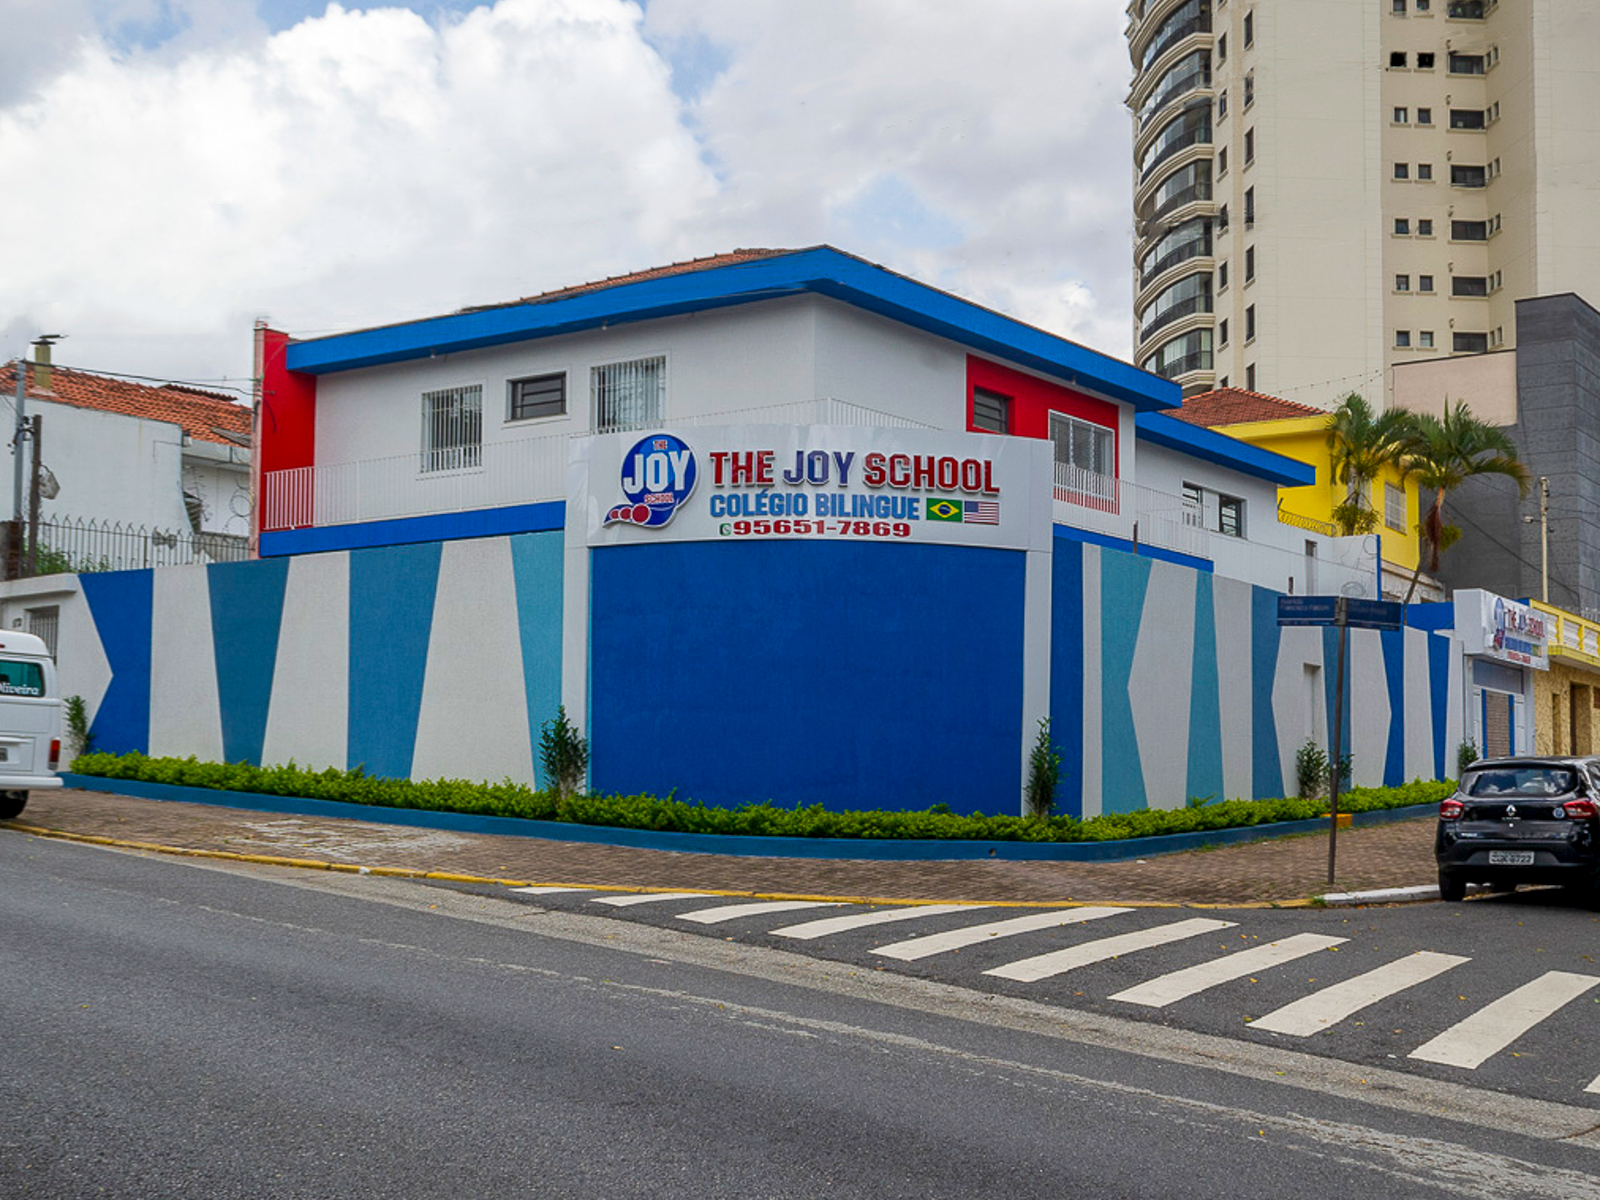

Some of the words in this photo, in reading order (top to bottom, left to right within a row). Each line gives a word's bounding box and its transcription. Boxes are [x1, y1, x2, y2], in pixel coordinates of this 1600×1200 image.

[653, 439, 668, 450] THE
[623, 450, 691, 494] JOY
[709, 450, 775, 487] THE
[783, 450, 855, 486] JOY
[863, 452, 1000, 496] SCHOOL
[644, 492, 674, 504] SCHOOL
[710, 489, 808, 518] COLÉGIO
[815, 493, 920, 521] BILINGUE
[733, 519, 911, 537] 95651-7869
